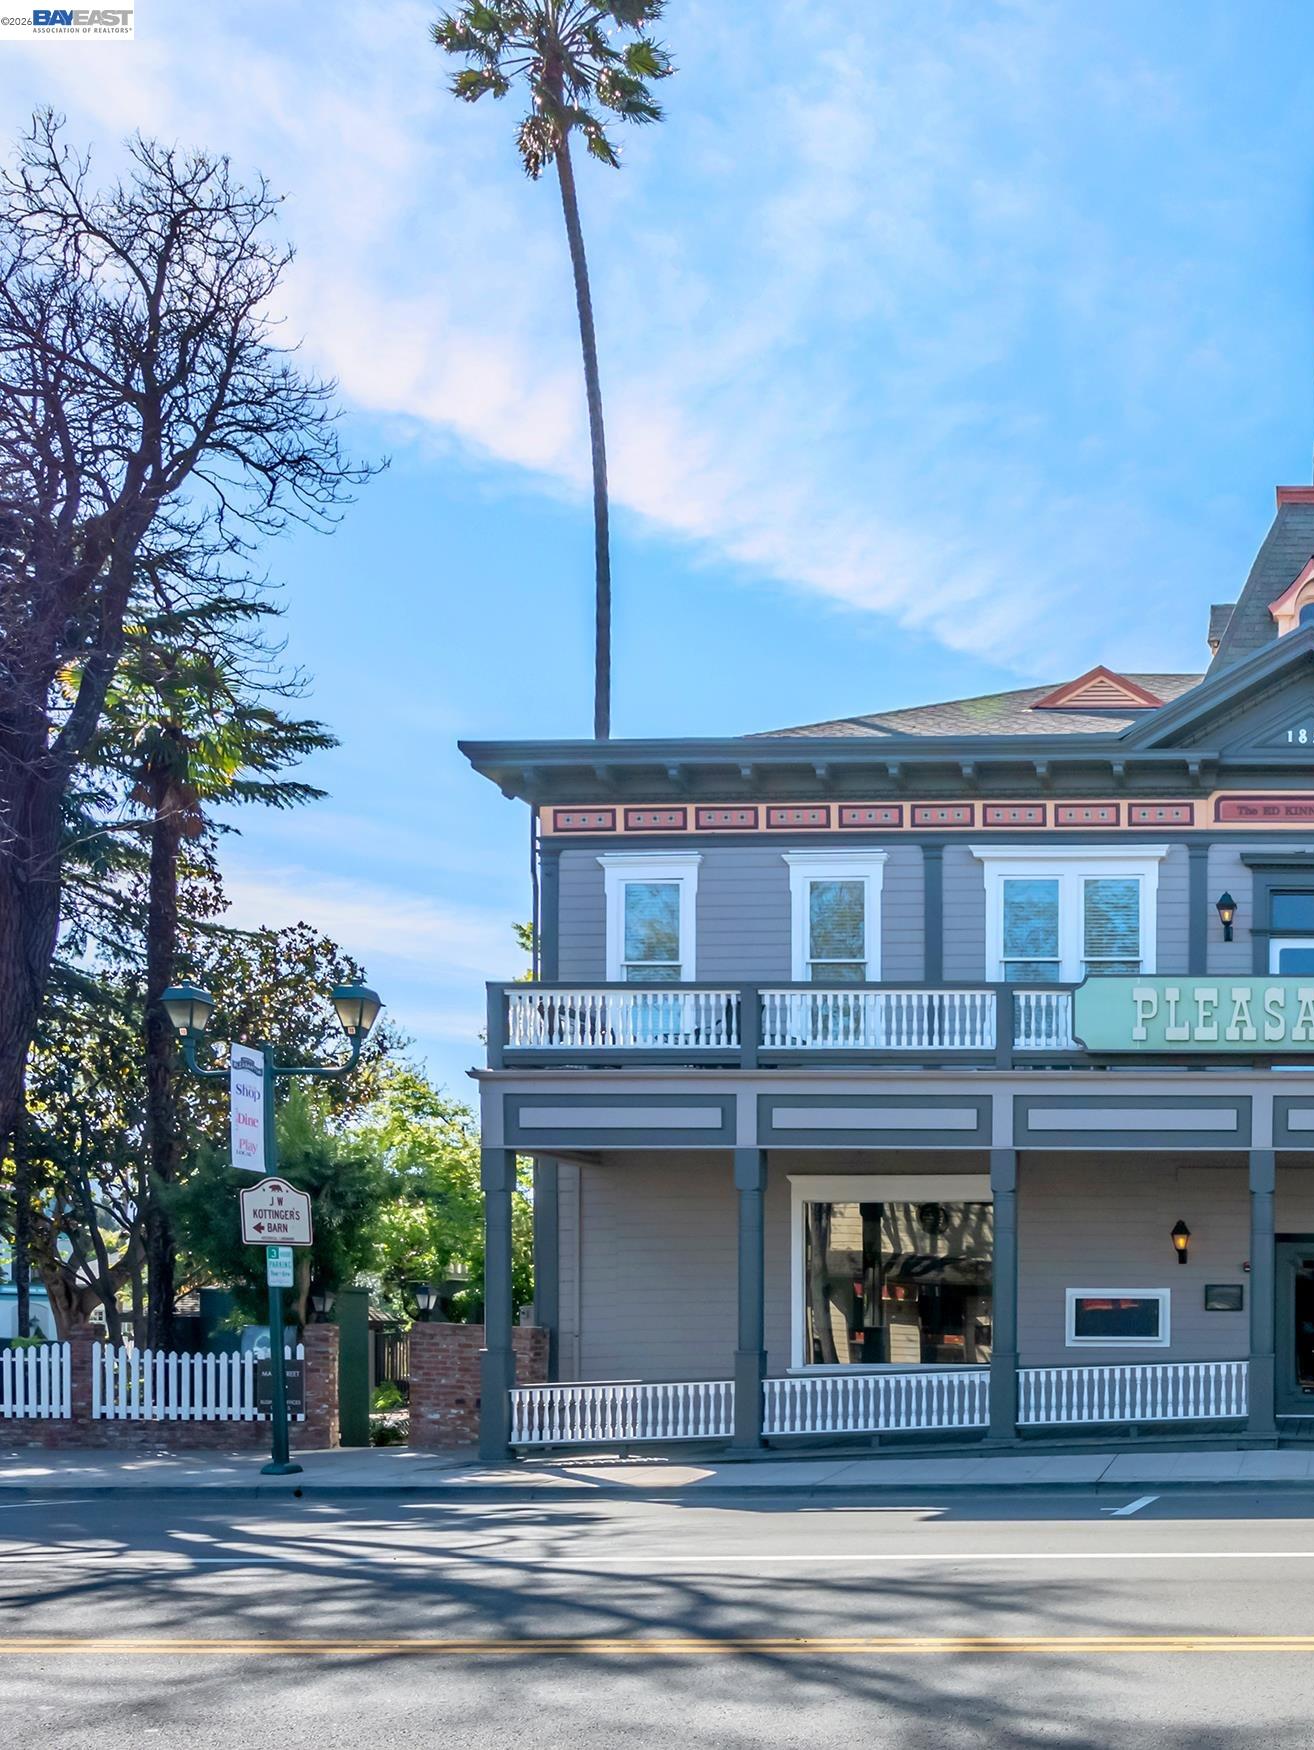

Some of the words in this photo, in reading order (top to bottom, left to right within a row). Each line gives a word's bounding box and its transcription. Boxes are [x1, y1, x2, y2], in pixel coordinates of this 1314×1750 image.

[1237, 806, 1258, 816] The
[1263, 806, 1280, 816] ED
[235, 1082, 261, 1102] Shop
[237, 1112, 259, 1128] Dine
[239, 1138, 258, 1154] Play
[269, 1196, 274, 1206] J
[277, 1196, 284, 1206] W
[252, 1208, 301, 1220] KOTTINGER'S
[267, 1222, 289, 1233] BARN
[271, 1248, 278, 1258] 3
